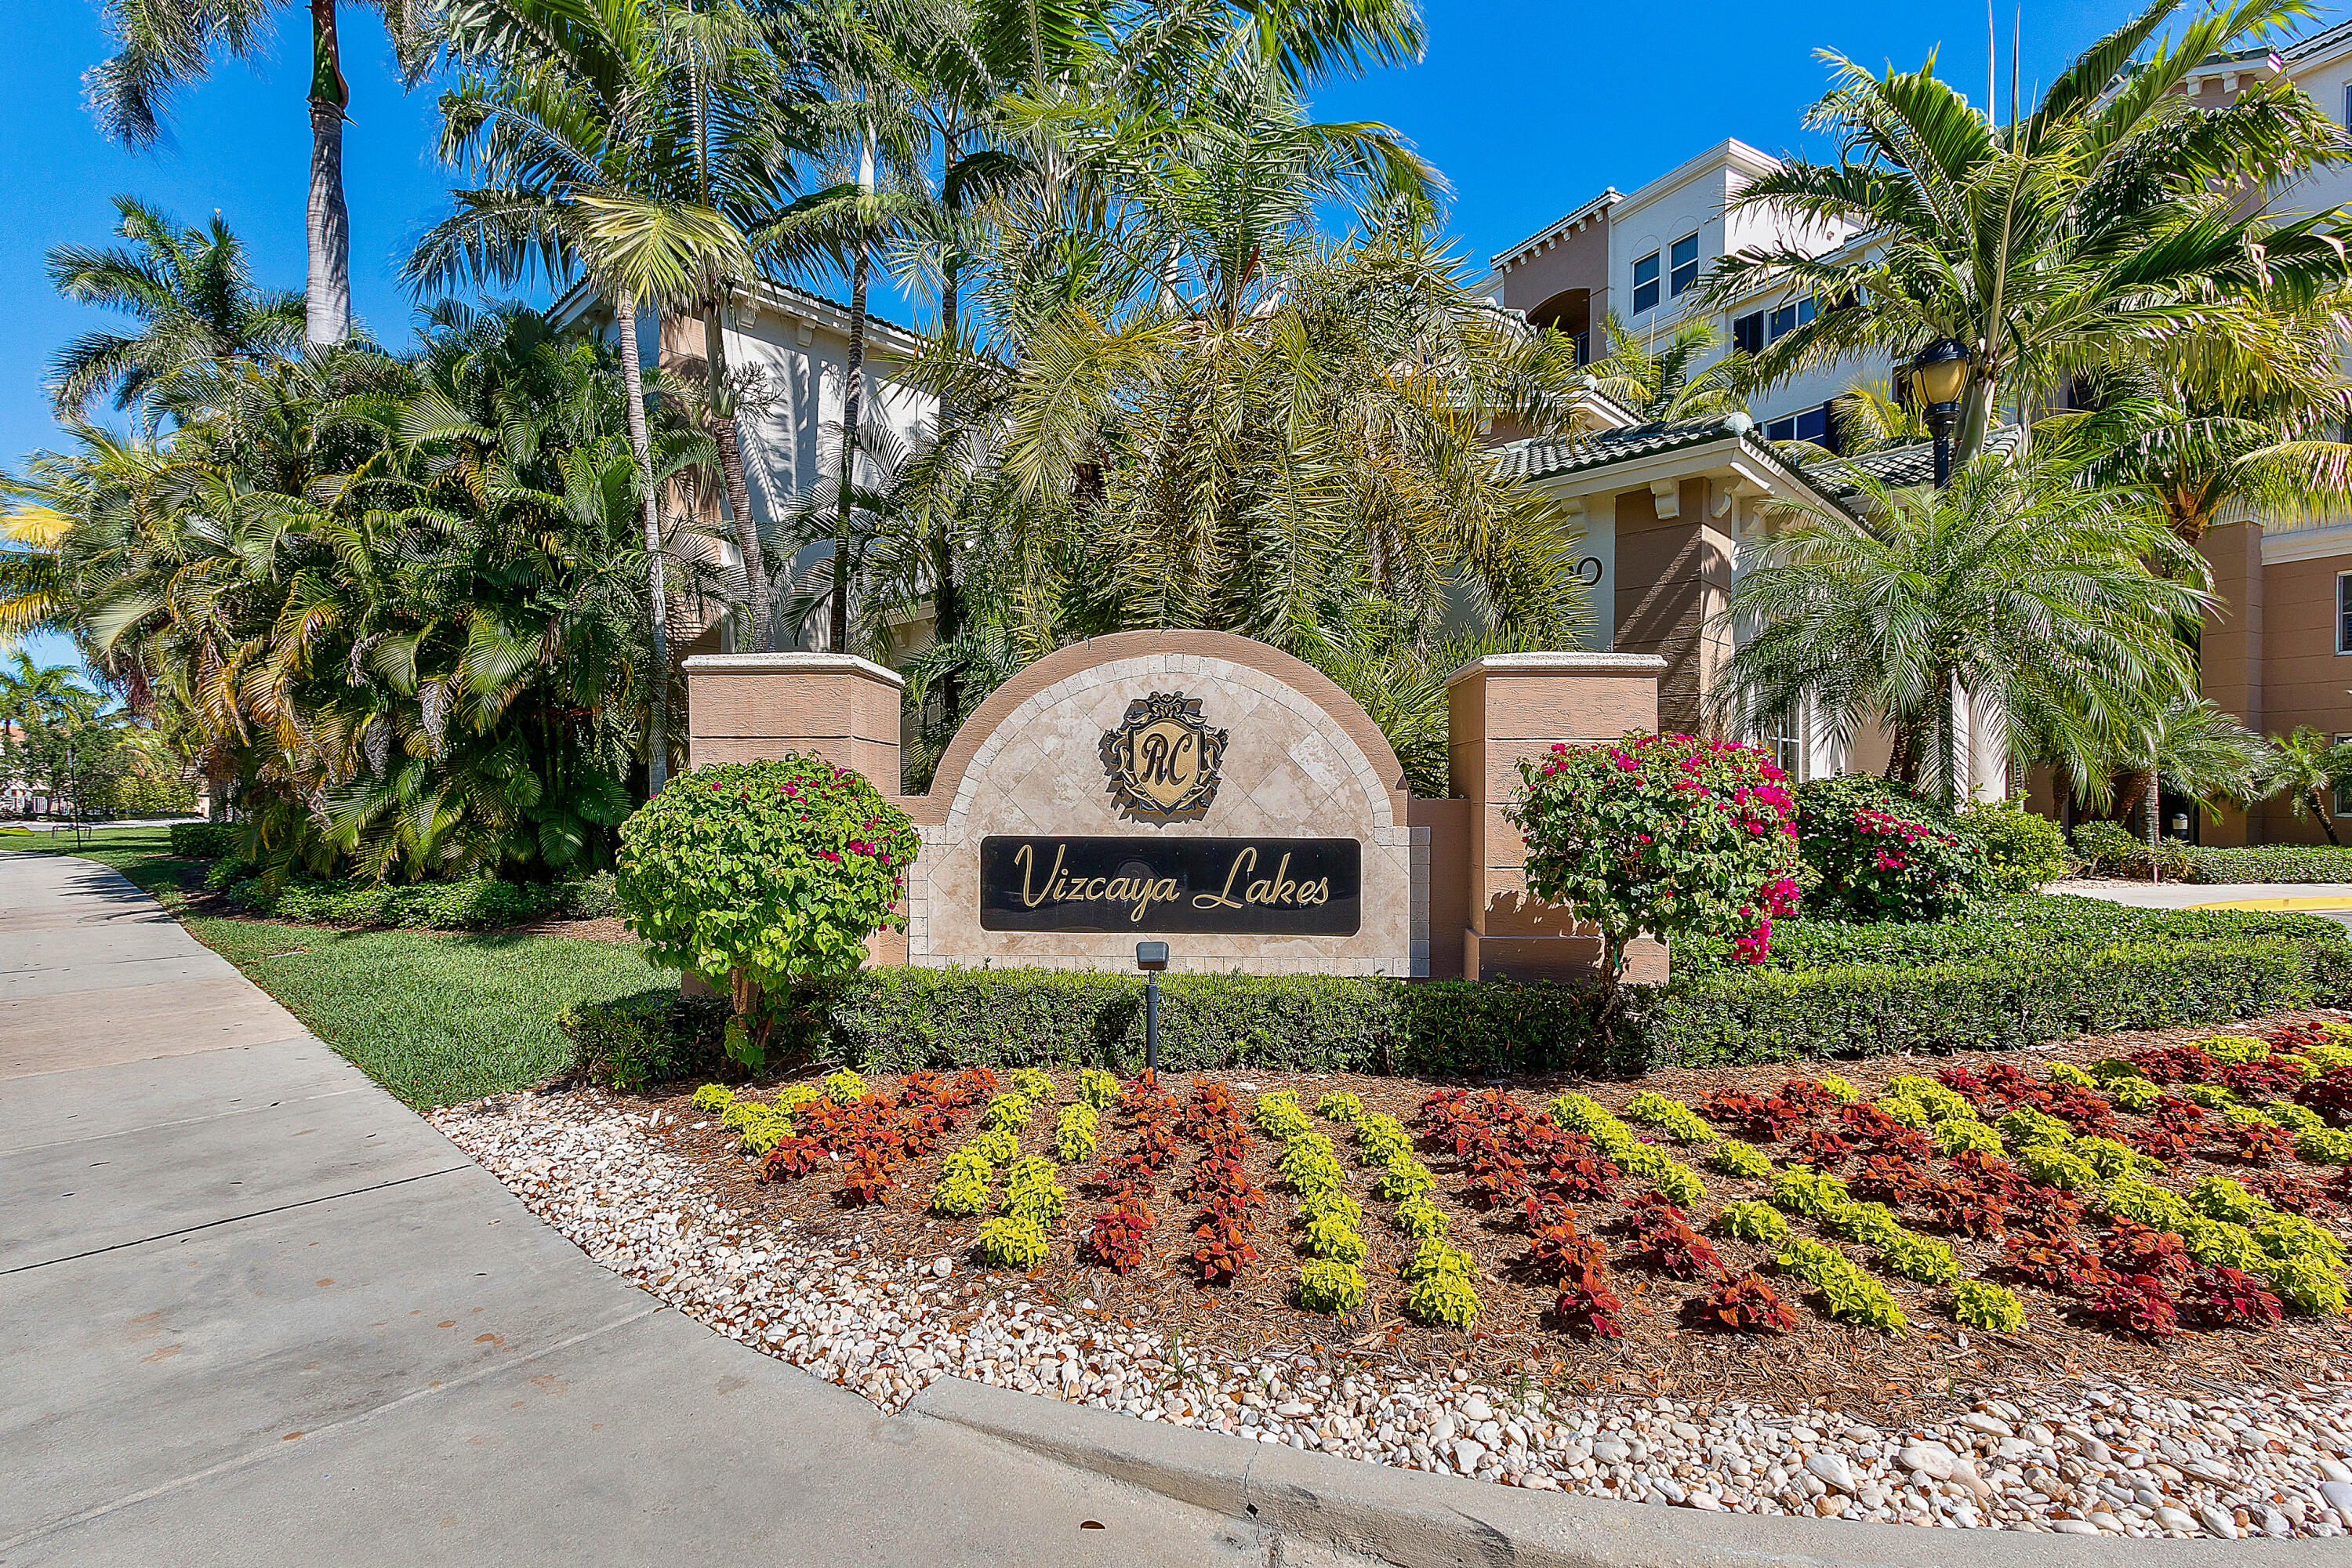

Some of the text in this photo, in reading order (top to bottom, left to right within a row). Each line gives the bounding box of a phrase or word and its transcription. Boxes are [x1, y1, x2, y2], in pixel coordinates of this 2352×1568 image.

[1141, 733, 1192, 786] RC
[1014, 844, 1329, 923] Vizcaya Lakes
